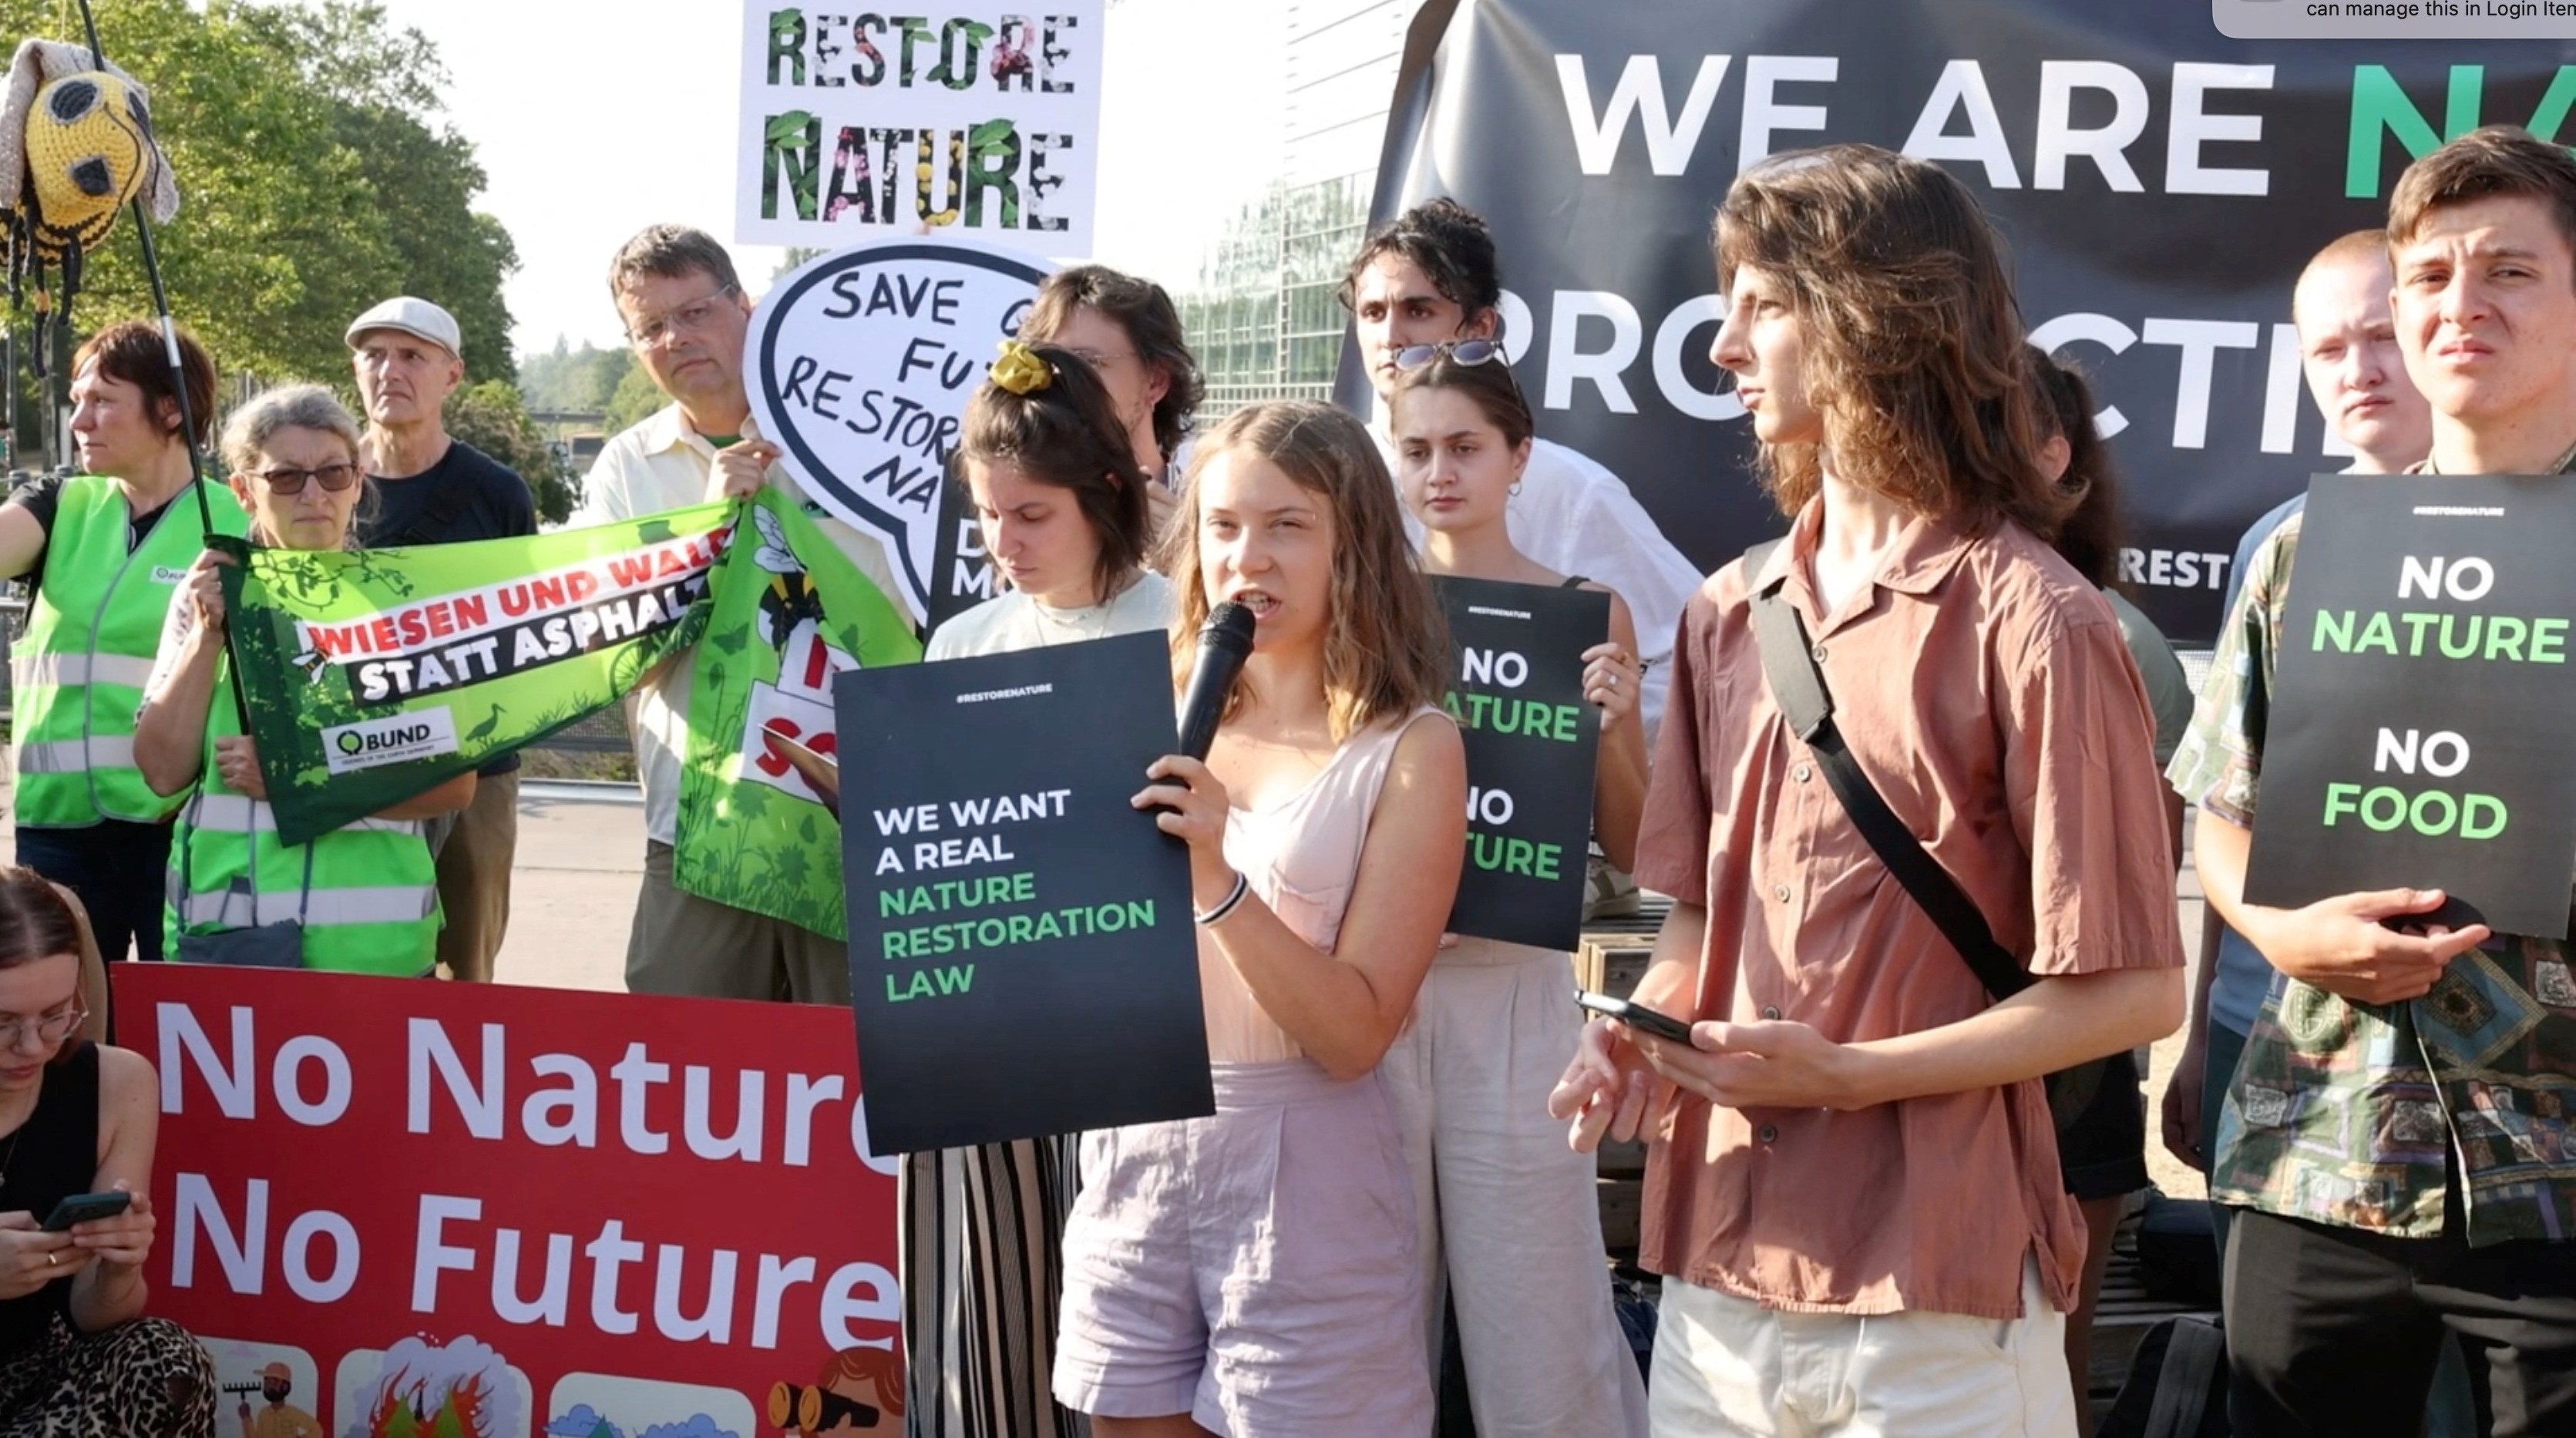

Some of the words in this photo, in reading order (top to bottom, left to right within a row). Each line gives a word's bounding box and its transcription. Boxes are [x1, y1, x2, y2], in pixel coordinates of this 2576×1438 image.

[767, 8, 1078, 93] RESTORE
[1554, 54, 1839, 176] WE
[1900, 59, 2275, 196] ARE
[761, 109, 1073, 231] NATURE
[823, 271, 964, 325] SAVE
[2397, 556, 2494, 601] NO
[309, 595, 489, 655] WIESEN
[498, 569, 598, 619] UND
[2312, 609, 2570, 663] NATURE
[359, 636, 499, 702] STATT
[956, 683, 1053, 704] #RESTORENATURE
[1462, 647, 1528, 688] NO
[366, 724, 430, 751] BUND
[2374, 727, 2470, 778] NO
[873, 804, 940, 836] WE
[950, 789, 1071, 828] WANT
[2323, 782, 2507, 839] FOOD
[875, 847, 904, 875] A
[914, 835, 1014, 871] REAL
[879, 872, 1036, 918] NATURE
[883, 899, 1155, 959] RESTORATION
[886, 964, 974, 1002] LAW
[156, 1002, 353, 1127] No
[170, 1171, 361, 1303] No
[411, 1192, 901, 1354] Future
